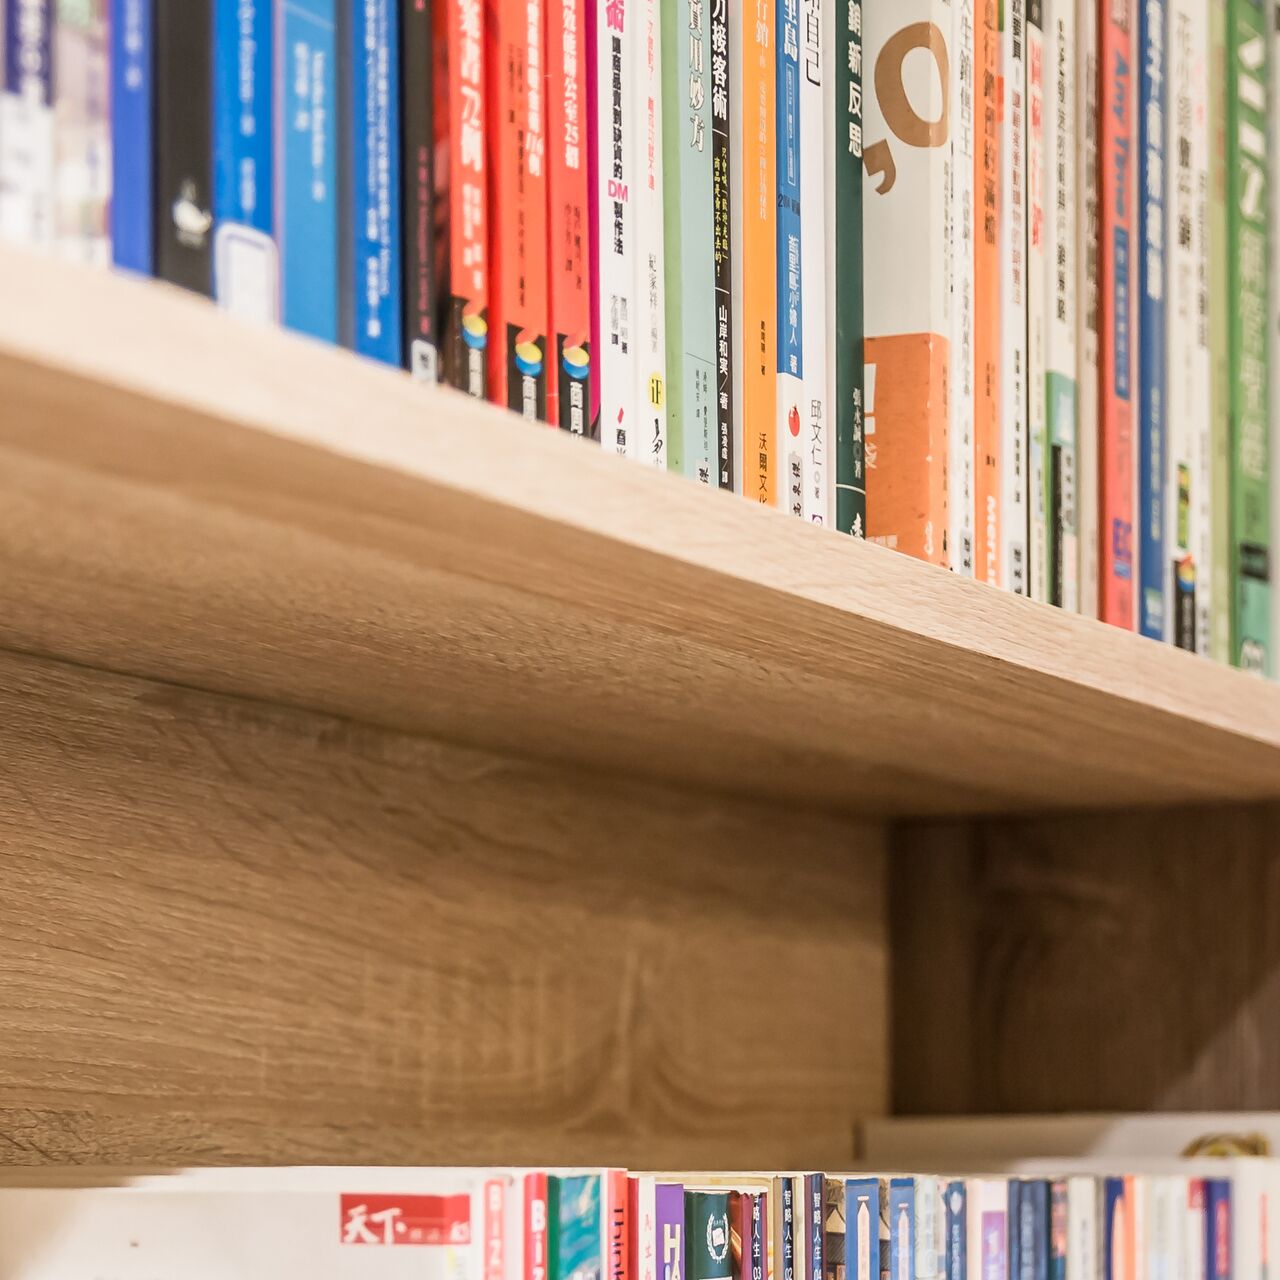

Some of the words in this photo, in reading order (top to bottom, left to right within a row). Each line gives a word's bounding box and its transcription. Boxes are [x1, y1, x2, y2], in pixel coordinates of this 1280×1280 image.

[608, 179, 628, 202] DM
[810, 398, 823, 466] 邱文仁
[784, 1189, 793, 1260] 智略人生
[813, 1192, 823, 1261] 智略人生
[752, 1266, 762, 1280] 03
